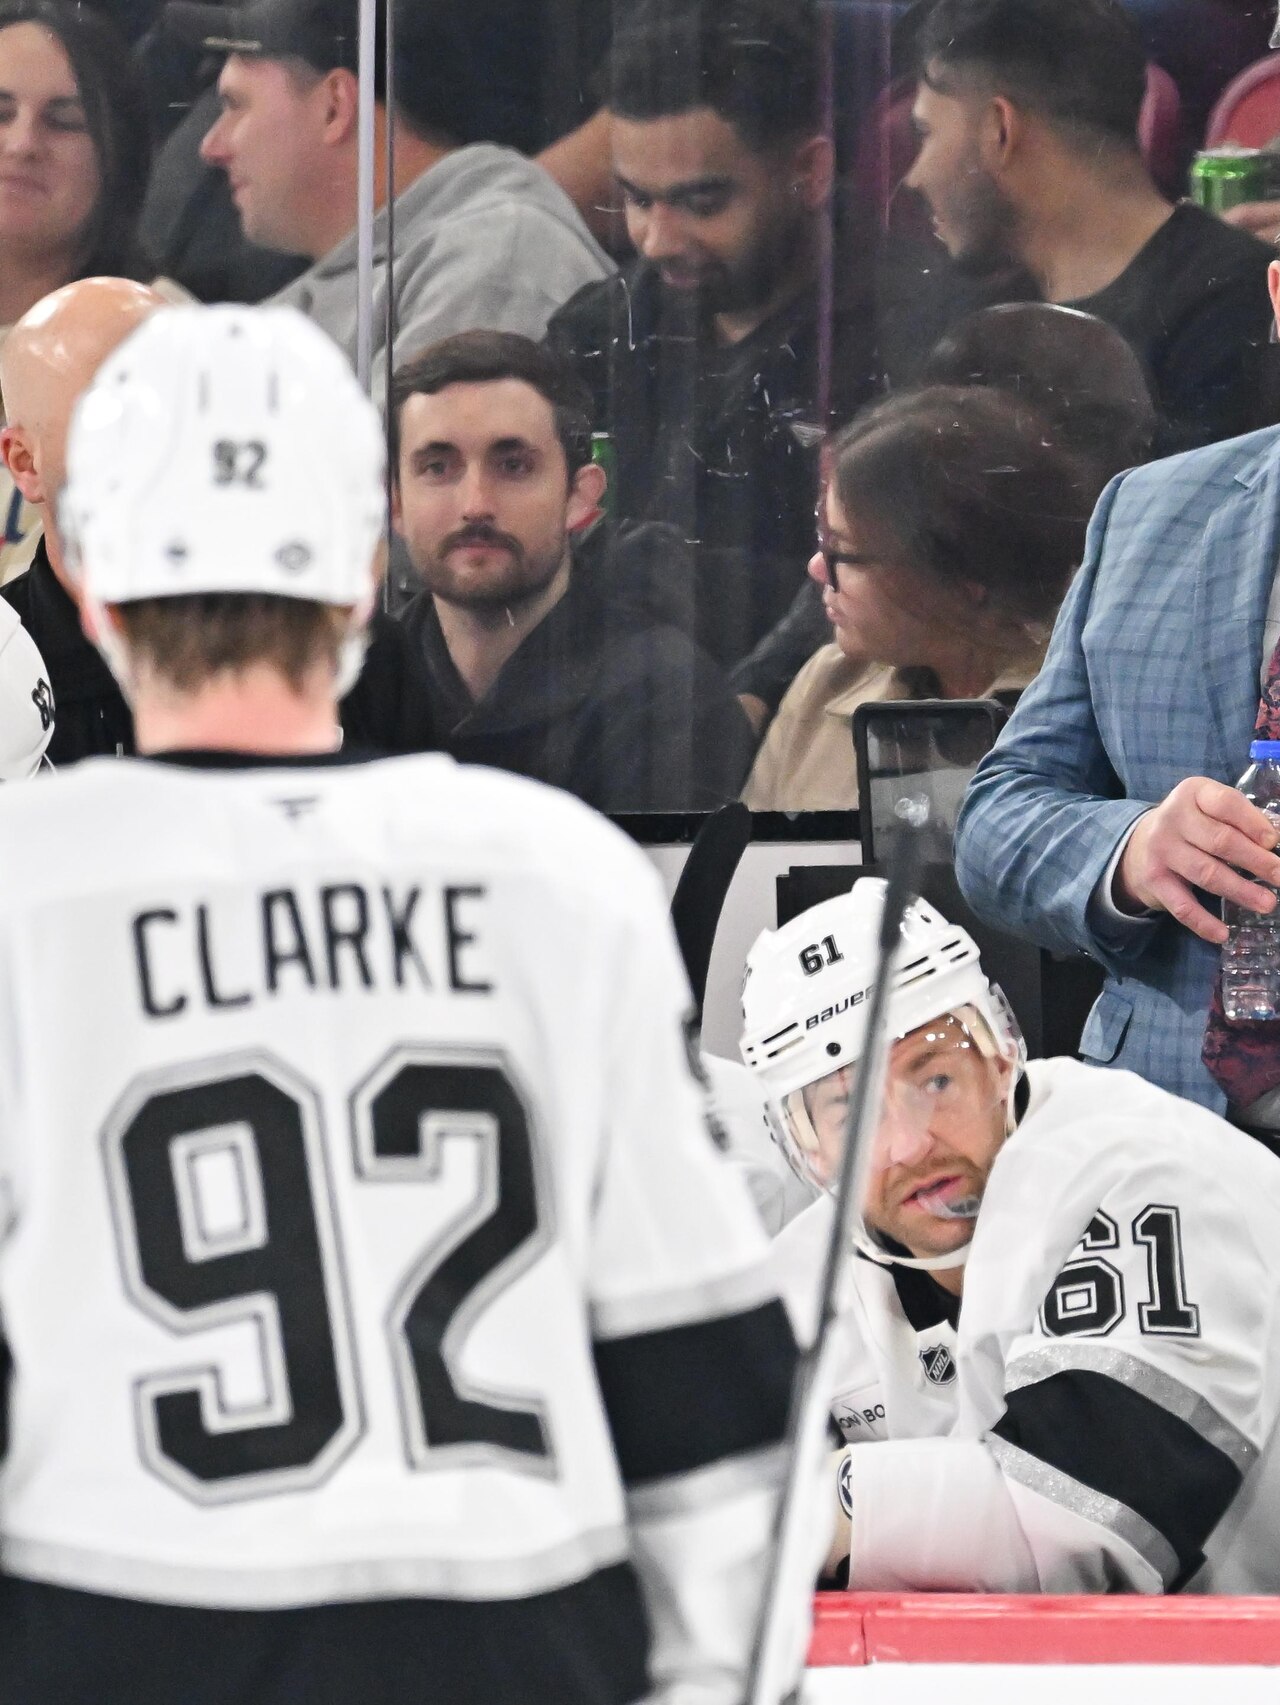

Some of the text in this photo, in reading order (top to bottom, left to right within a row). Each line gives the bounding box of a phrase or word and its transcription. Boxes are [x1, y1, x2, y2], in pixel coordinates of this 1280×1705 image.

[132, 882, 494, 1020] CLARKE
[798, 934, 845, 977] 61
[98, 1041, 562, 1511] 92
[1039, 1204, 1201, 1338] 61
[863, 1403, 886, 1423] BO
